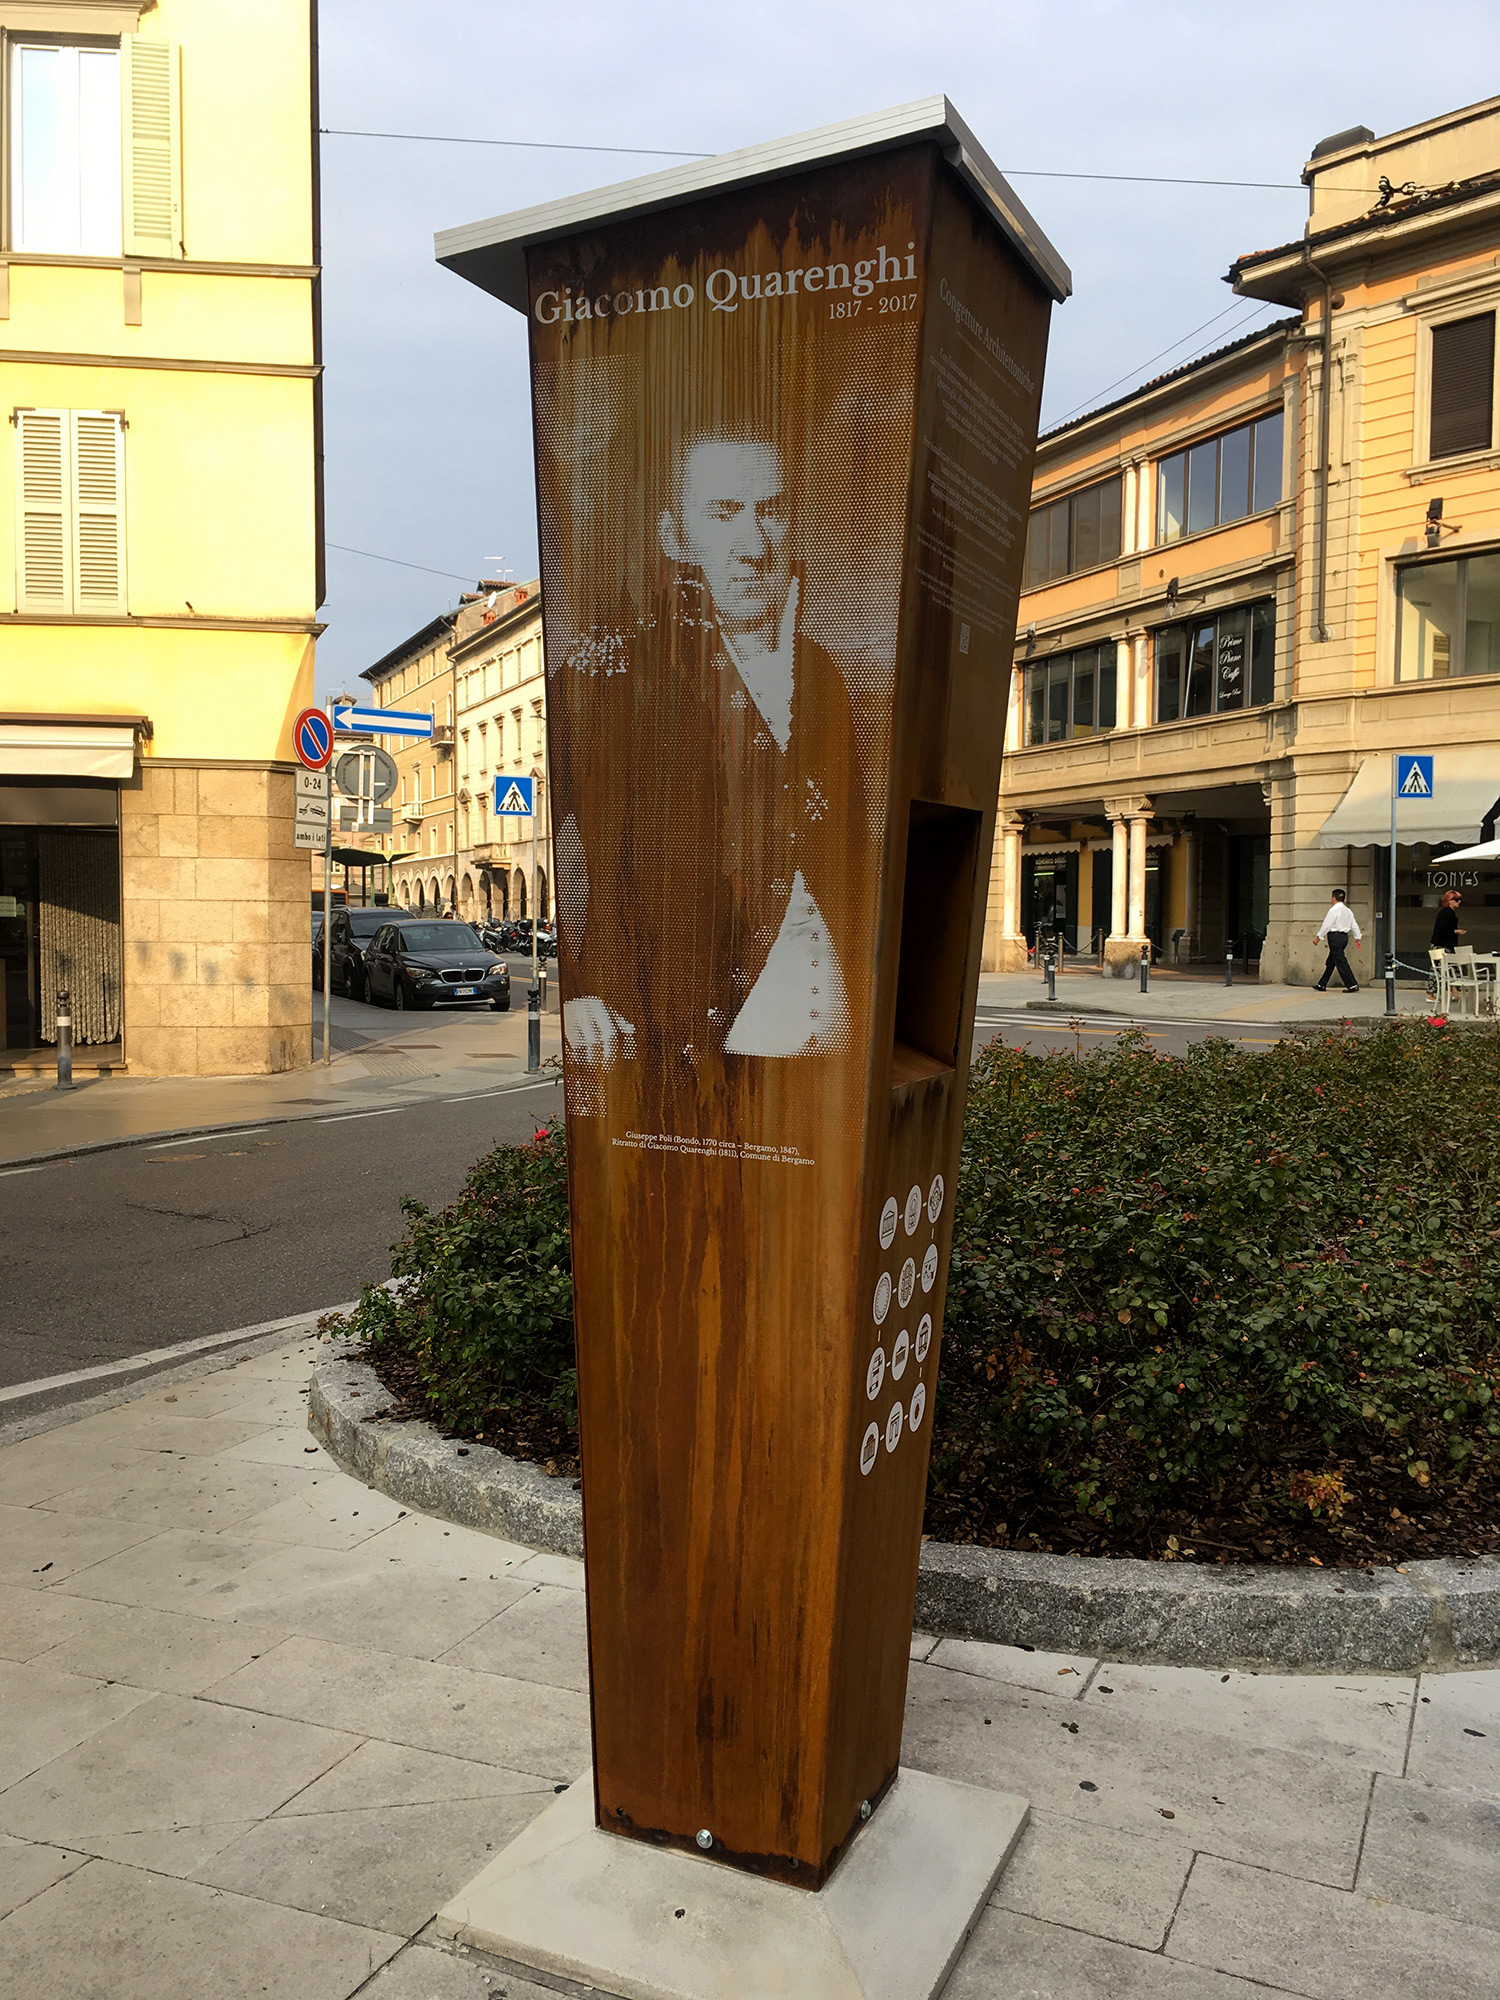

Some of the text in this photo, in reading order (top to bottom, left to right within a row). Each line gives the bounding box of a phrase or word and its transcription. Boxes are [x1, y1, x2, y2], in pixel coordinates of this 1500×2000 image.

[534, 242, 918, 326] Giacomo Quarenghi
[828, 300, 863, 320] 1817
[878, 293, 918, 315] 2017
[939, 276, 984, 341] Congetture
[983, 325, 1036, 396] Architettoniche
[304, 776, 321, 790] 0-24
[296, 831, 311, 841] ambo
[315, 833, 326, 843] lati
[611, 1137, 638, 1148] Ritratto
[638, 1141, 647, 1149] di
[647, 1142, 679, 1152] Giacomo
[679, 1144, 718, 1157] Quarenghi
[739, 1150, 771, 1161] Comune
[771, 1153, 781, 1162] di
[781, 1155, 815, 1166] Bergamo
[625, 1130, 658, 1142] Giuseppe
[659, 1134, 673, 1143] Poli
[673, 1135, 702, 1146] (Bondo,
[702, 1138, 718, 1147] 1770
[718, 1140, 736, 1149] circa
[744, 1142, 779, 1154] Bergamo,
[779, 1145, 800, 1156] 1847),
